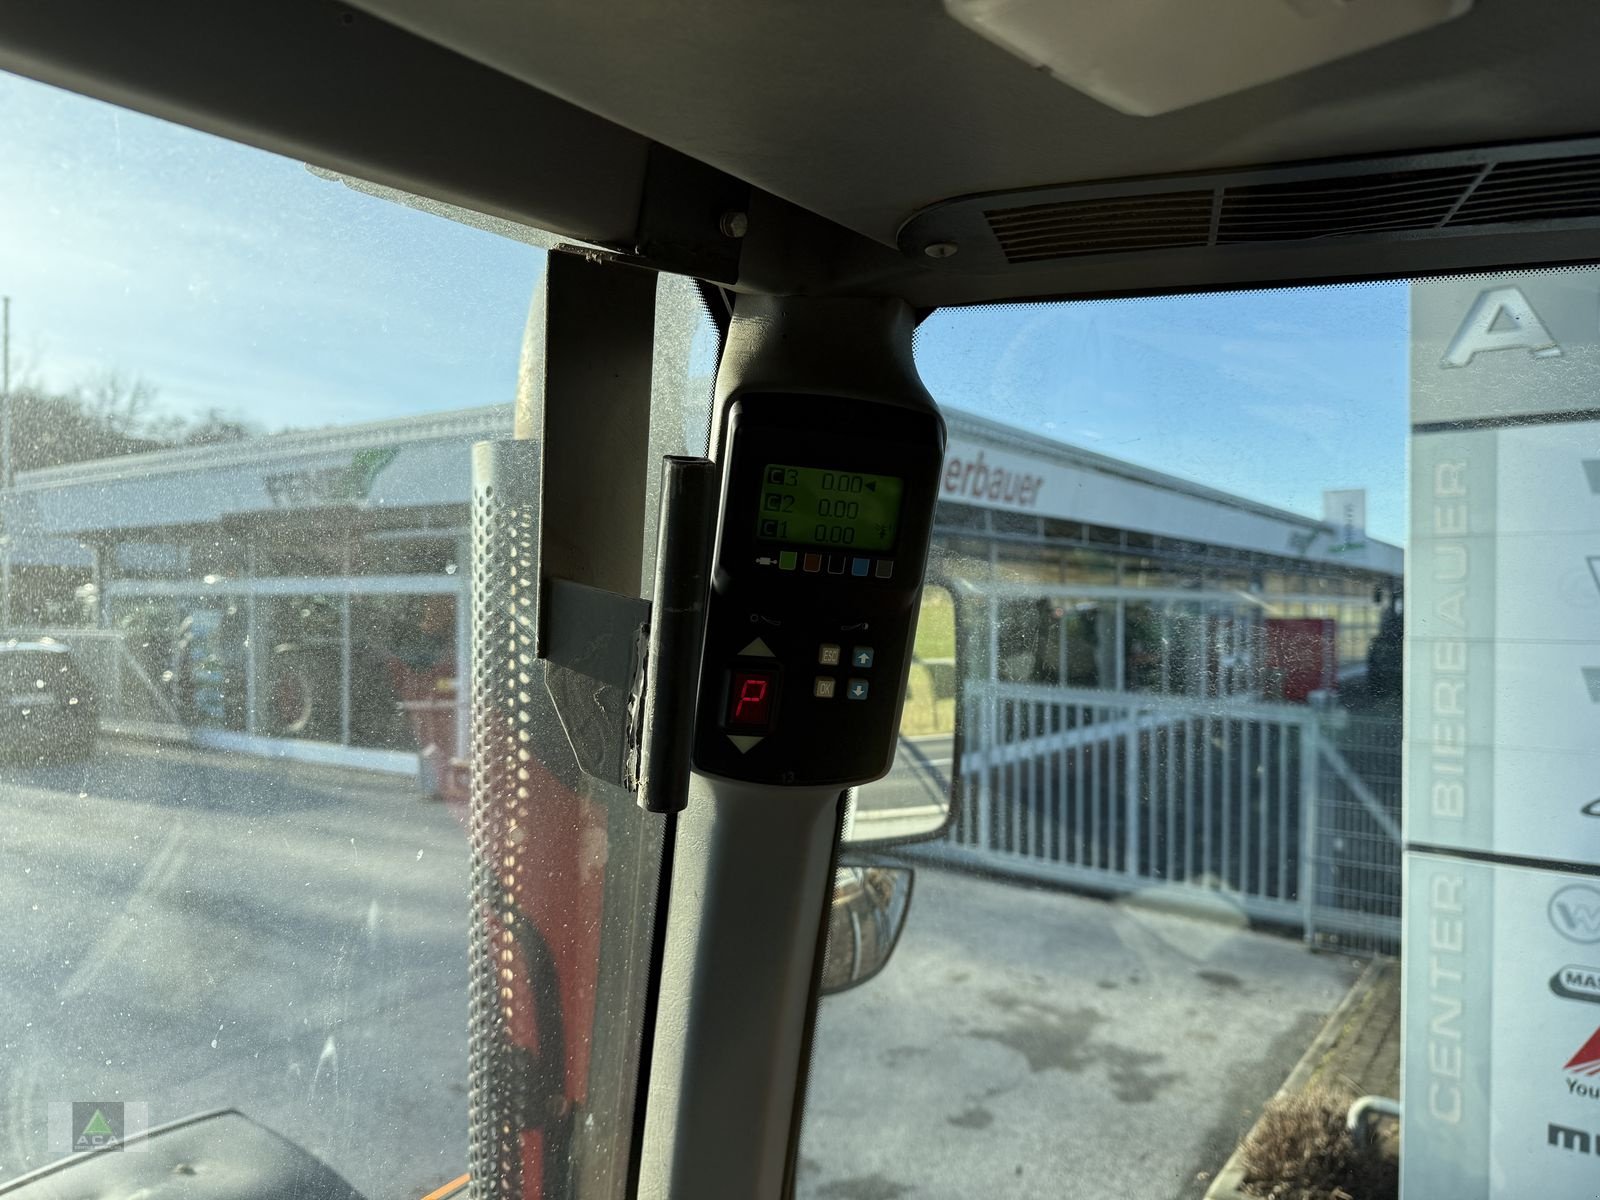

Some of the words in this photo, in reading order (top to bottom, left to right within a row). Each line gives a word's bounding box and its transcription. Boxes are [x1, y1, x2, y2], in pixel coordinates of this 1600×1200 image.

[822, 473, 863, 494] 0.00
[943, 450, 1044, 507] erbauer
[818, 499, 859, 520] 0.00
[814, 524, 855, 544] 0.00
[823, 648, 838, 662] ESC
[735, 680, 768, 716] P
[819, 682, 831, 695] OK
[1566, 971, 1600, 988] MA
[1429, 871, 1464, 1125] CENTER
[1547, 1122, 1600, 1156] m
